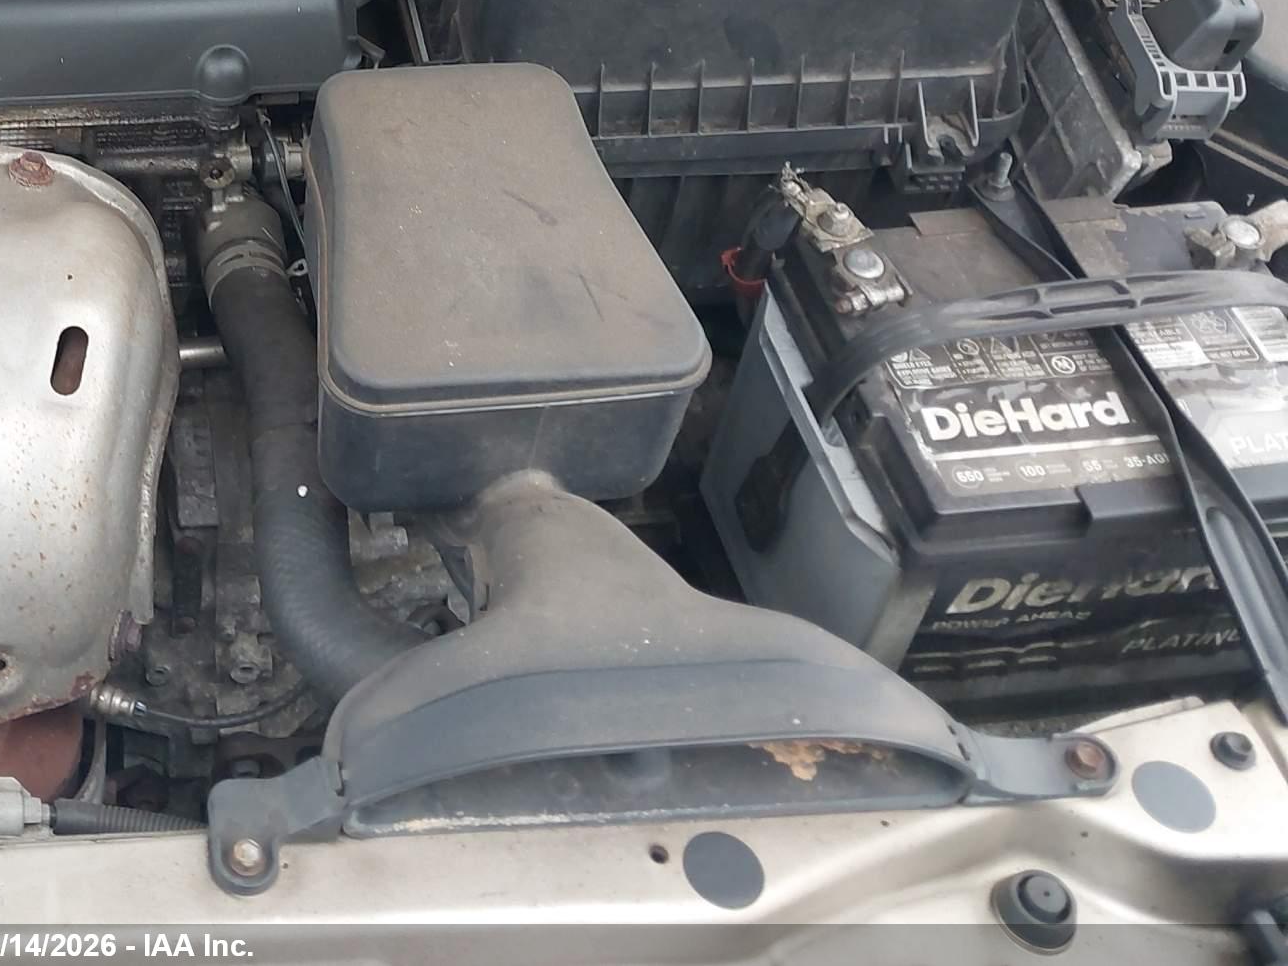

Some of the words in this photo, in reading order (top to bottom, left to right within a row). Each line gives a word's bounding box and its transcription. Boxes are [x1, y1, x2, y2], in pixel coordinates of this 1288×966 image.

[920, 390, 1131, 442] DieHard
[1020, 464, 1046, 477] 100
[1121, 627, 1241, 655] PLATINU
